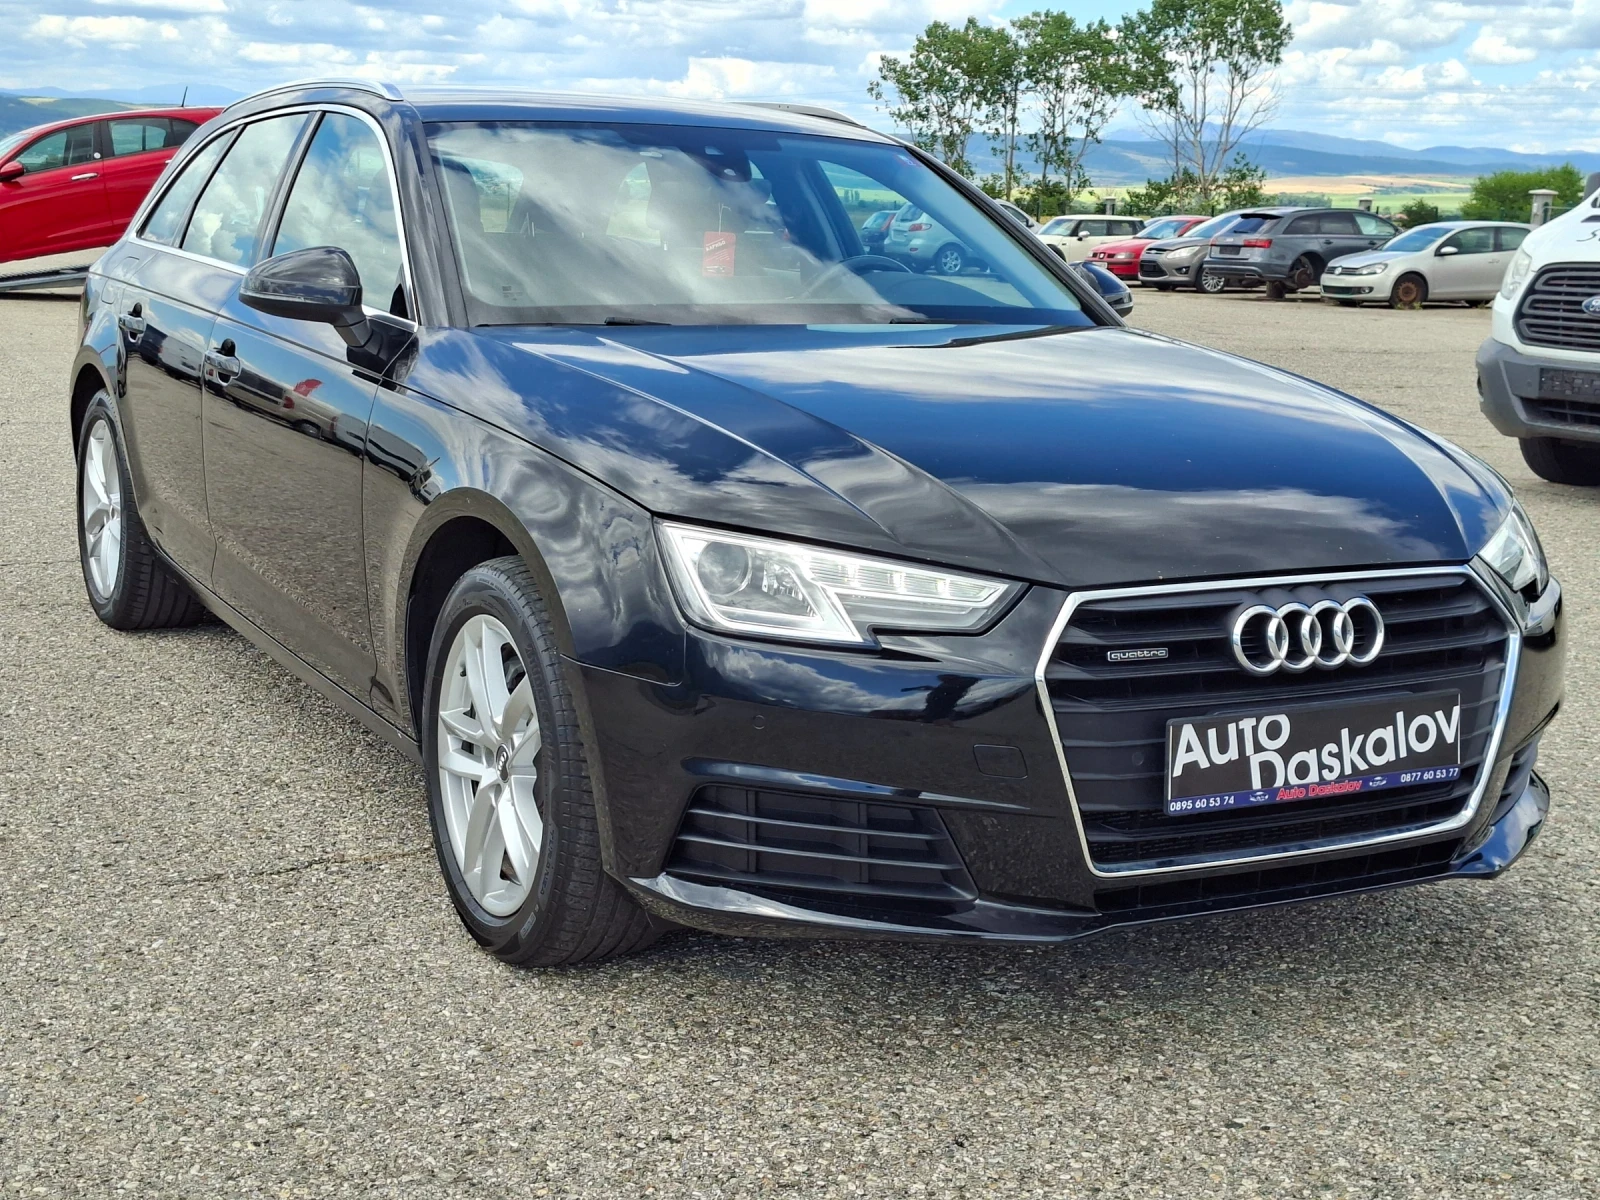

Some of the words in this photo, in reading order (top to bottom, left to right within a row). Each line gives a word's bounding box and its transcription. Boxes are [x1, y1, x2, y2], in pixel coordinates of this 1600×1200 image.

[1111, 650, 1166, 660] quattro
[1250, 705, 1460, 790] Daskalov
[1400, 771, 1421, 783] 0877
[1423, 770, 1434, 780] 60
[1436, 769, 1447, 779] 53
[1448, 767, 1459, 777] 77
[1276, 786, 1306, 801] Auto
[1308, 779, 1363, 797] Daskalov
[1169, 800, 1193, 811] 0895
[1195, 798, 1207, 809] 60
[1208, 797, 1221, 807] 53
[1223, 795, 1235, 805] 74
